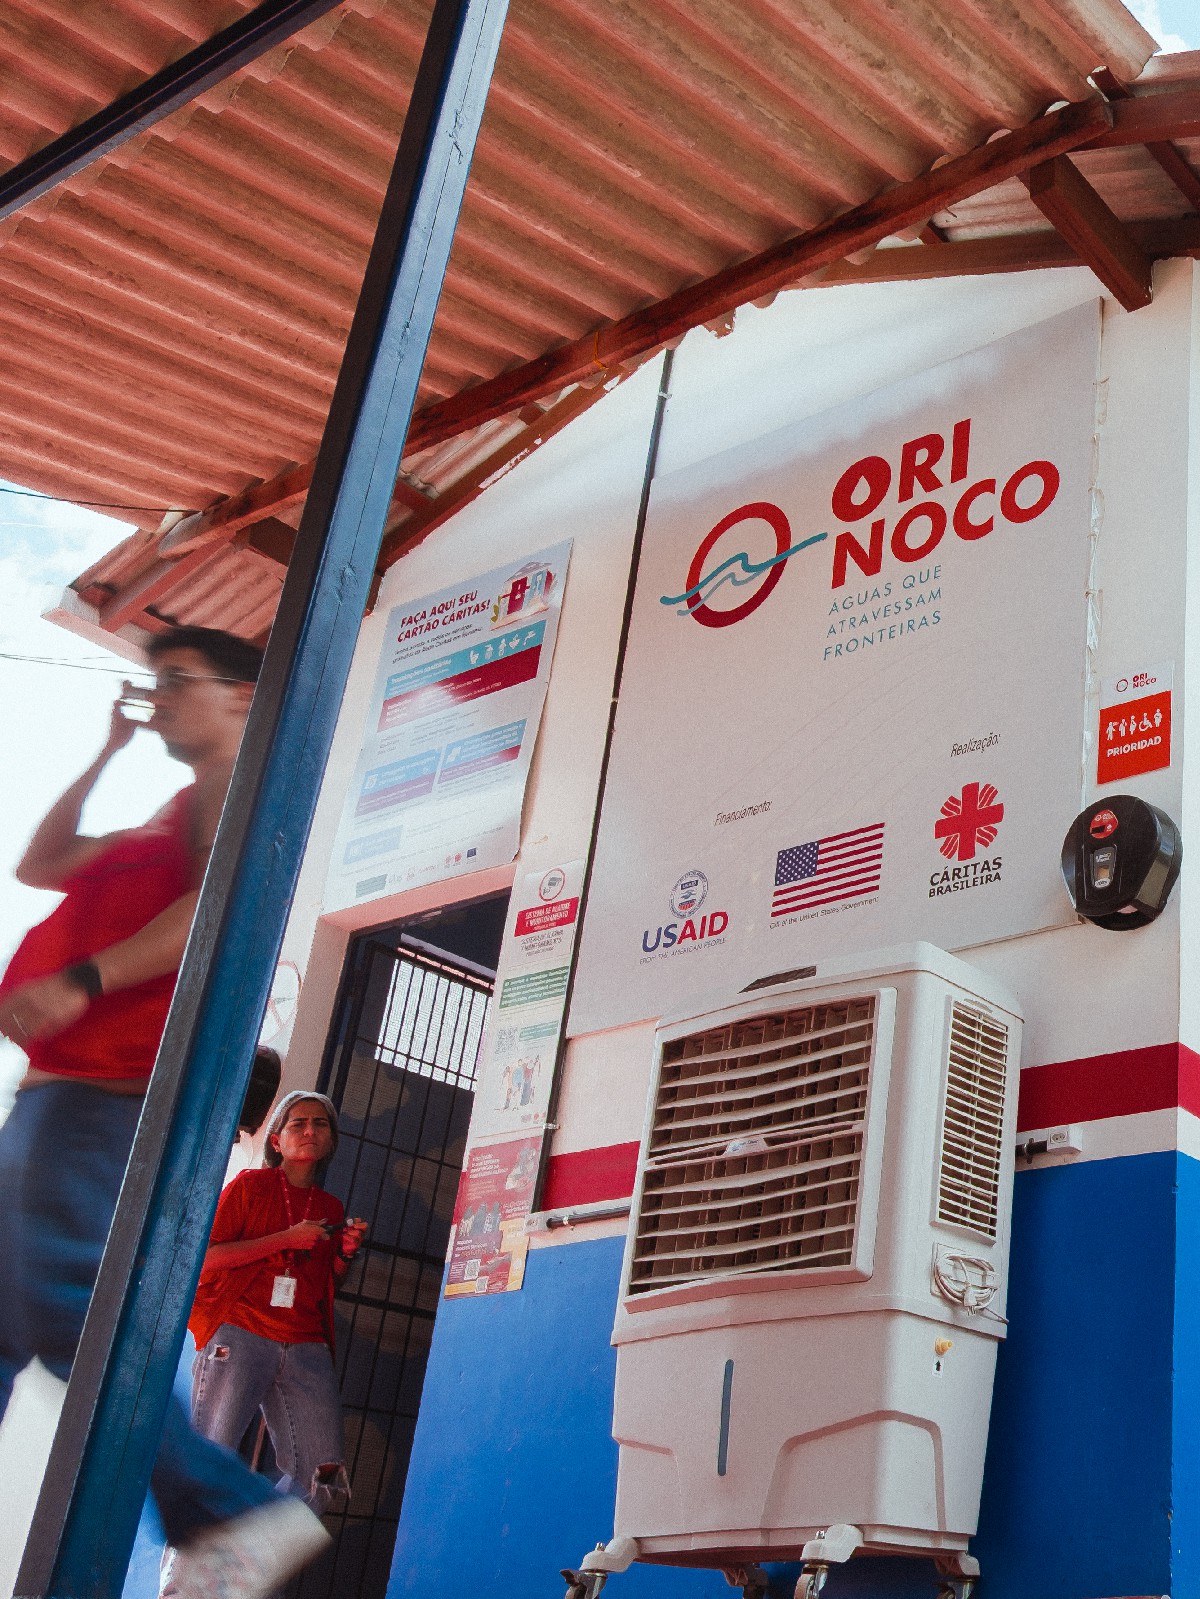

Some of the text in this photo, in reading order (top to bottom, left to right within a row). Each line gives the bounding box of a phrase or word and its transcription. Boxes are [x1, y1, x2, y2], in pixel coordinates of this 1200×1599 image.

[831, 418, 971, 522] ORI
[831, 460, 1060, 590] NOCO
[400, 590, 478, 629] FAÇA AQUI SEU
[828, 564, 942, 616] ÁGUAS QUE
[397, 599, 491, 643] CARTÃO CÁRITAS!
[826, 586, 942, 638] ATRAVESSAM
[823, 610, 941, 661] FRONTEIRAS
[1132, 673, 1148, 683] ORI
[1132, 677, 1157, 689] NOCO
[950, 732, 1001, 758] Realização:
[1106, 735, 1162, 758] PRIORIDAD
[714, 801, 773, 826] Financiamento:
[928, 872, 1002, 898] BRASILEIRA
[929, 856, 1003, 887] CÁRITAS
[642, 911, 729, 953] USAID
